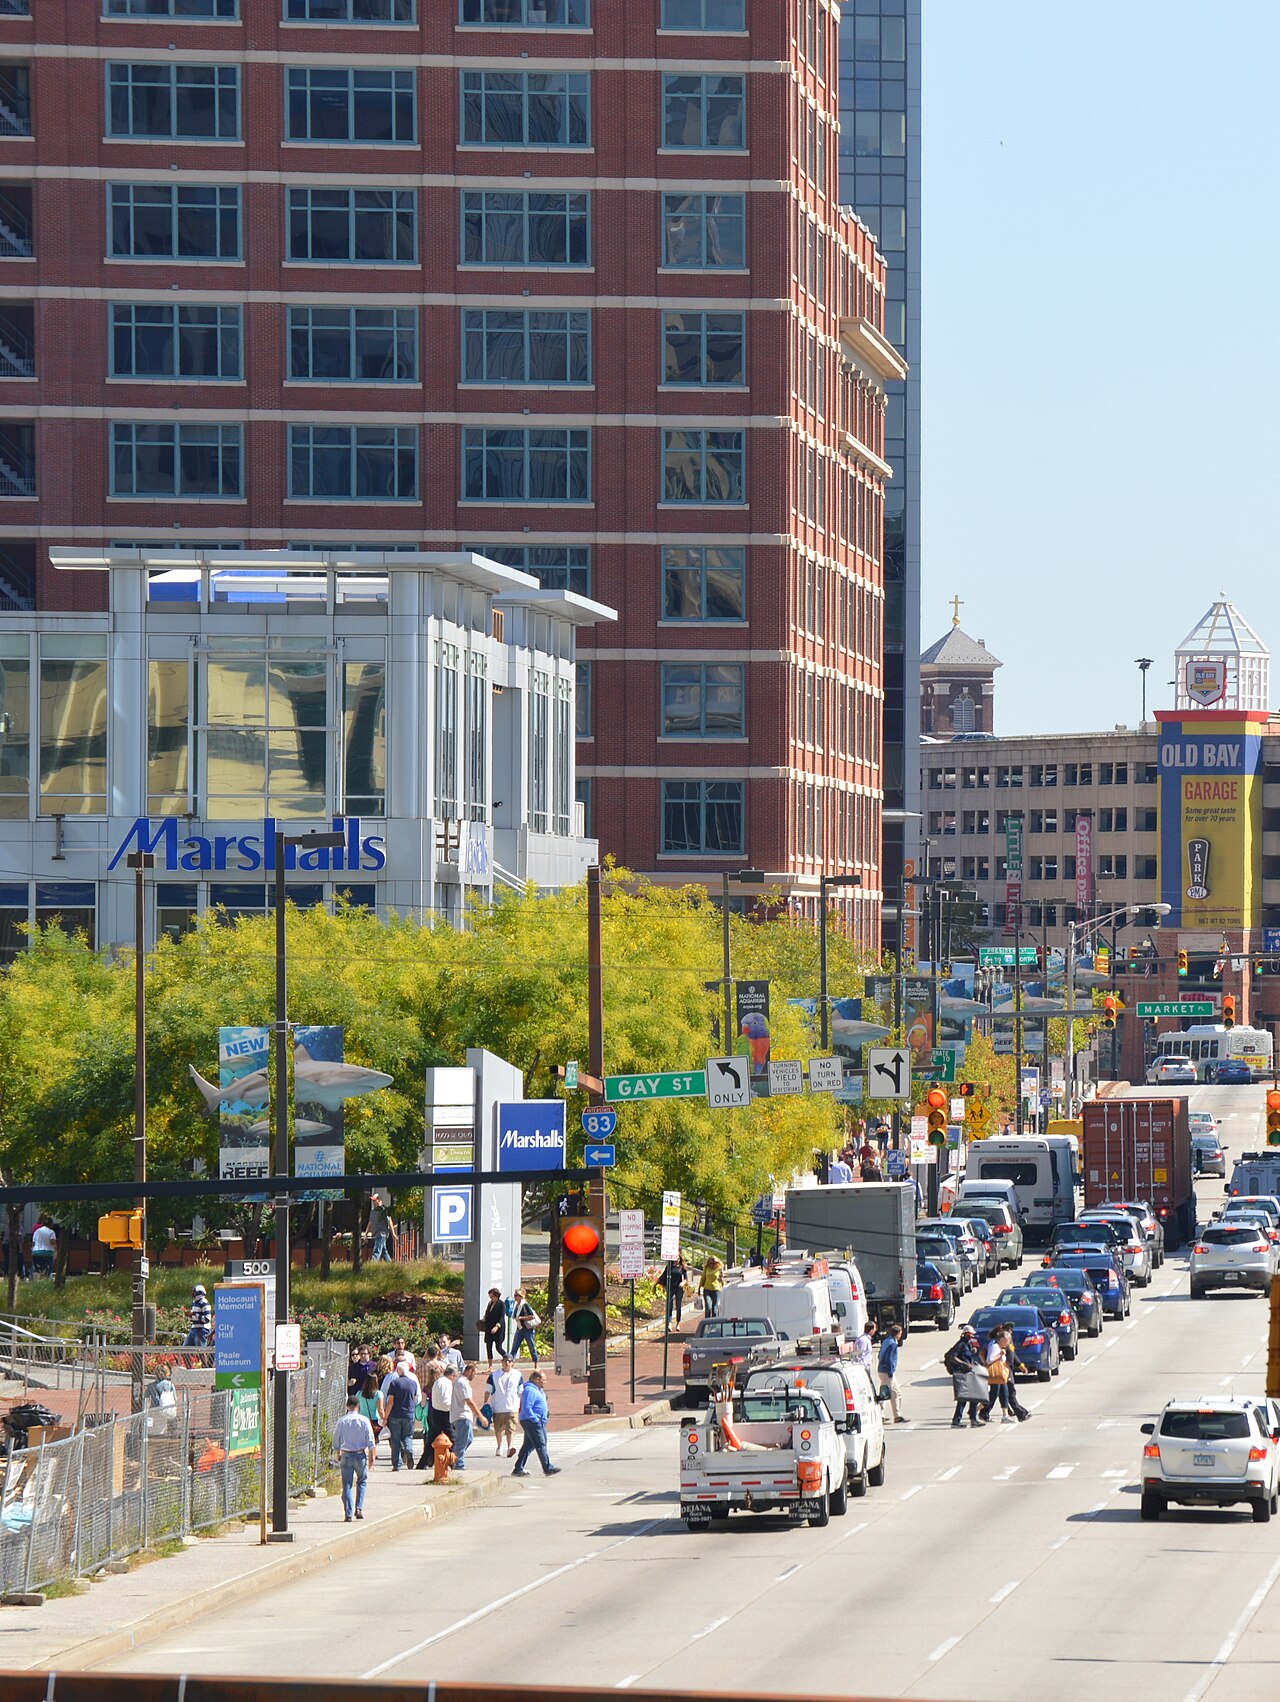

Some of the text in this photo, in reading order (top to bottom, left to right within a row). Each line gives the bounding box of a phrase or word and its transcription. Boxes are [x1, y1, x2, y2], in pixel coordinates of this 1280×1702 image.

[1161, 744, 1198, 767] OLD
[1185, 781, 1238, 800] GARAGE
[1203, 807, 1220, 815] great
[1218, 815, 1236, 823] years
[107, 817, 386, 871] Marshalls
[1008, 819, 1020, 869] LITTLE
[1077, 820, 1090, 876] Office
[1193, 843, 1202, 883] PARK
[1189, 888, 1204, 898] PMI
[995, 987, 1012, 996] NEW
[1144, 1005, 1194, 1014] MARKET
[226, 1037, 265, 1057] NEW
[817, 1070, 836, 1078] TURN
[618, 1077, 693, 1096] GAY ST
[813, 1080, 823, 1088] ON
[714, 1093, 744, 1104] ONLY
[587, 1115, 611, 1133] 83
[500, 1130, 564, 1148] Marshalls
[297, 1162, 342, 1171] NATIONAL
[222, 1166, 269, 1179] REEF
[439, 1195, 466, 1235] P
[242, 1261, 270, 1275] 500
[490, 1241, 503, 1289] KWOOD
[218, 1295, 257, 1303] Holocaust
[218, 1324, 234, 1332] City
[218, 1331, 233, 1339] Hall
[218, 1352, 241, 1360] Peale
[218, 1358, 251, 1366] Museum
[681, 1504, 712, 1514] DEJANA
